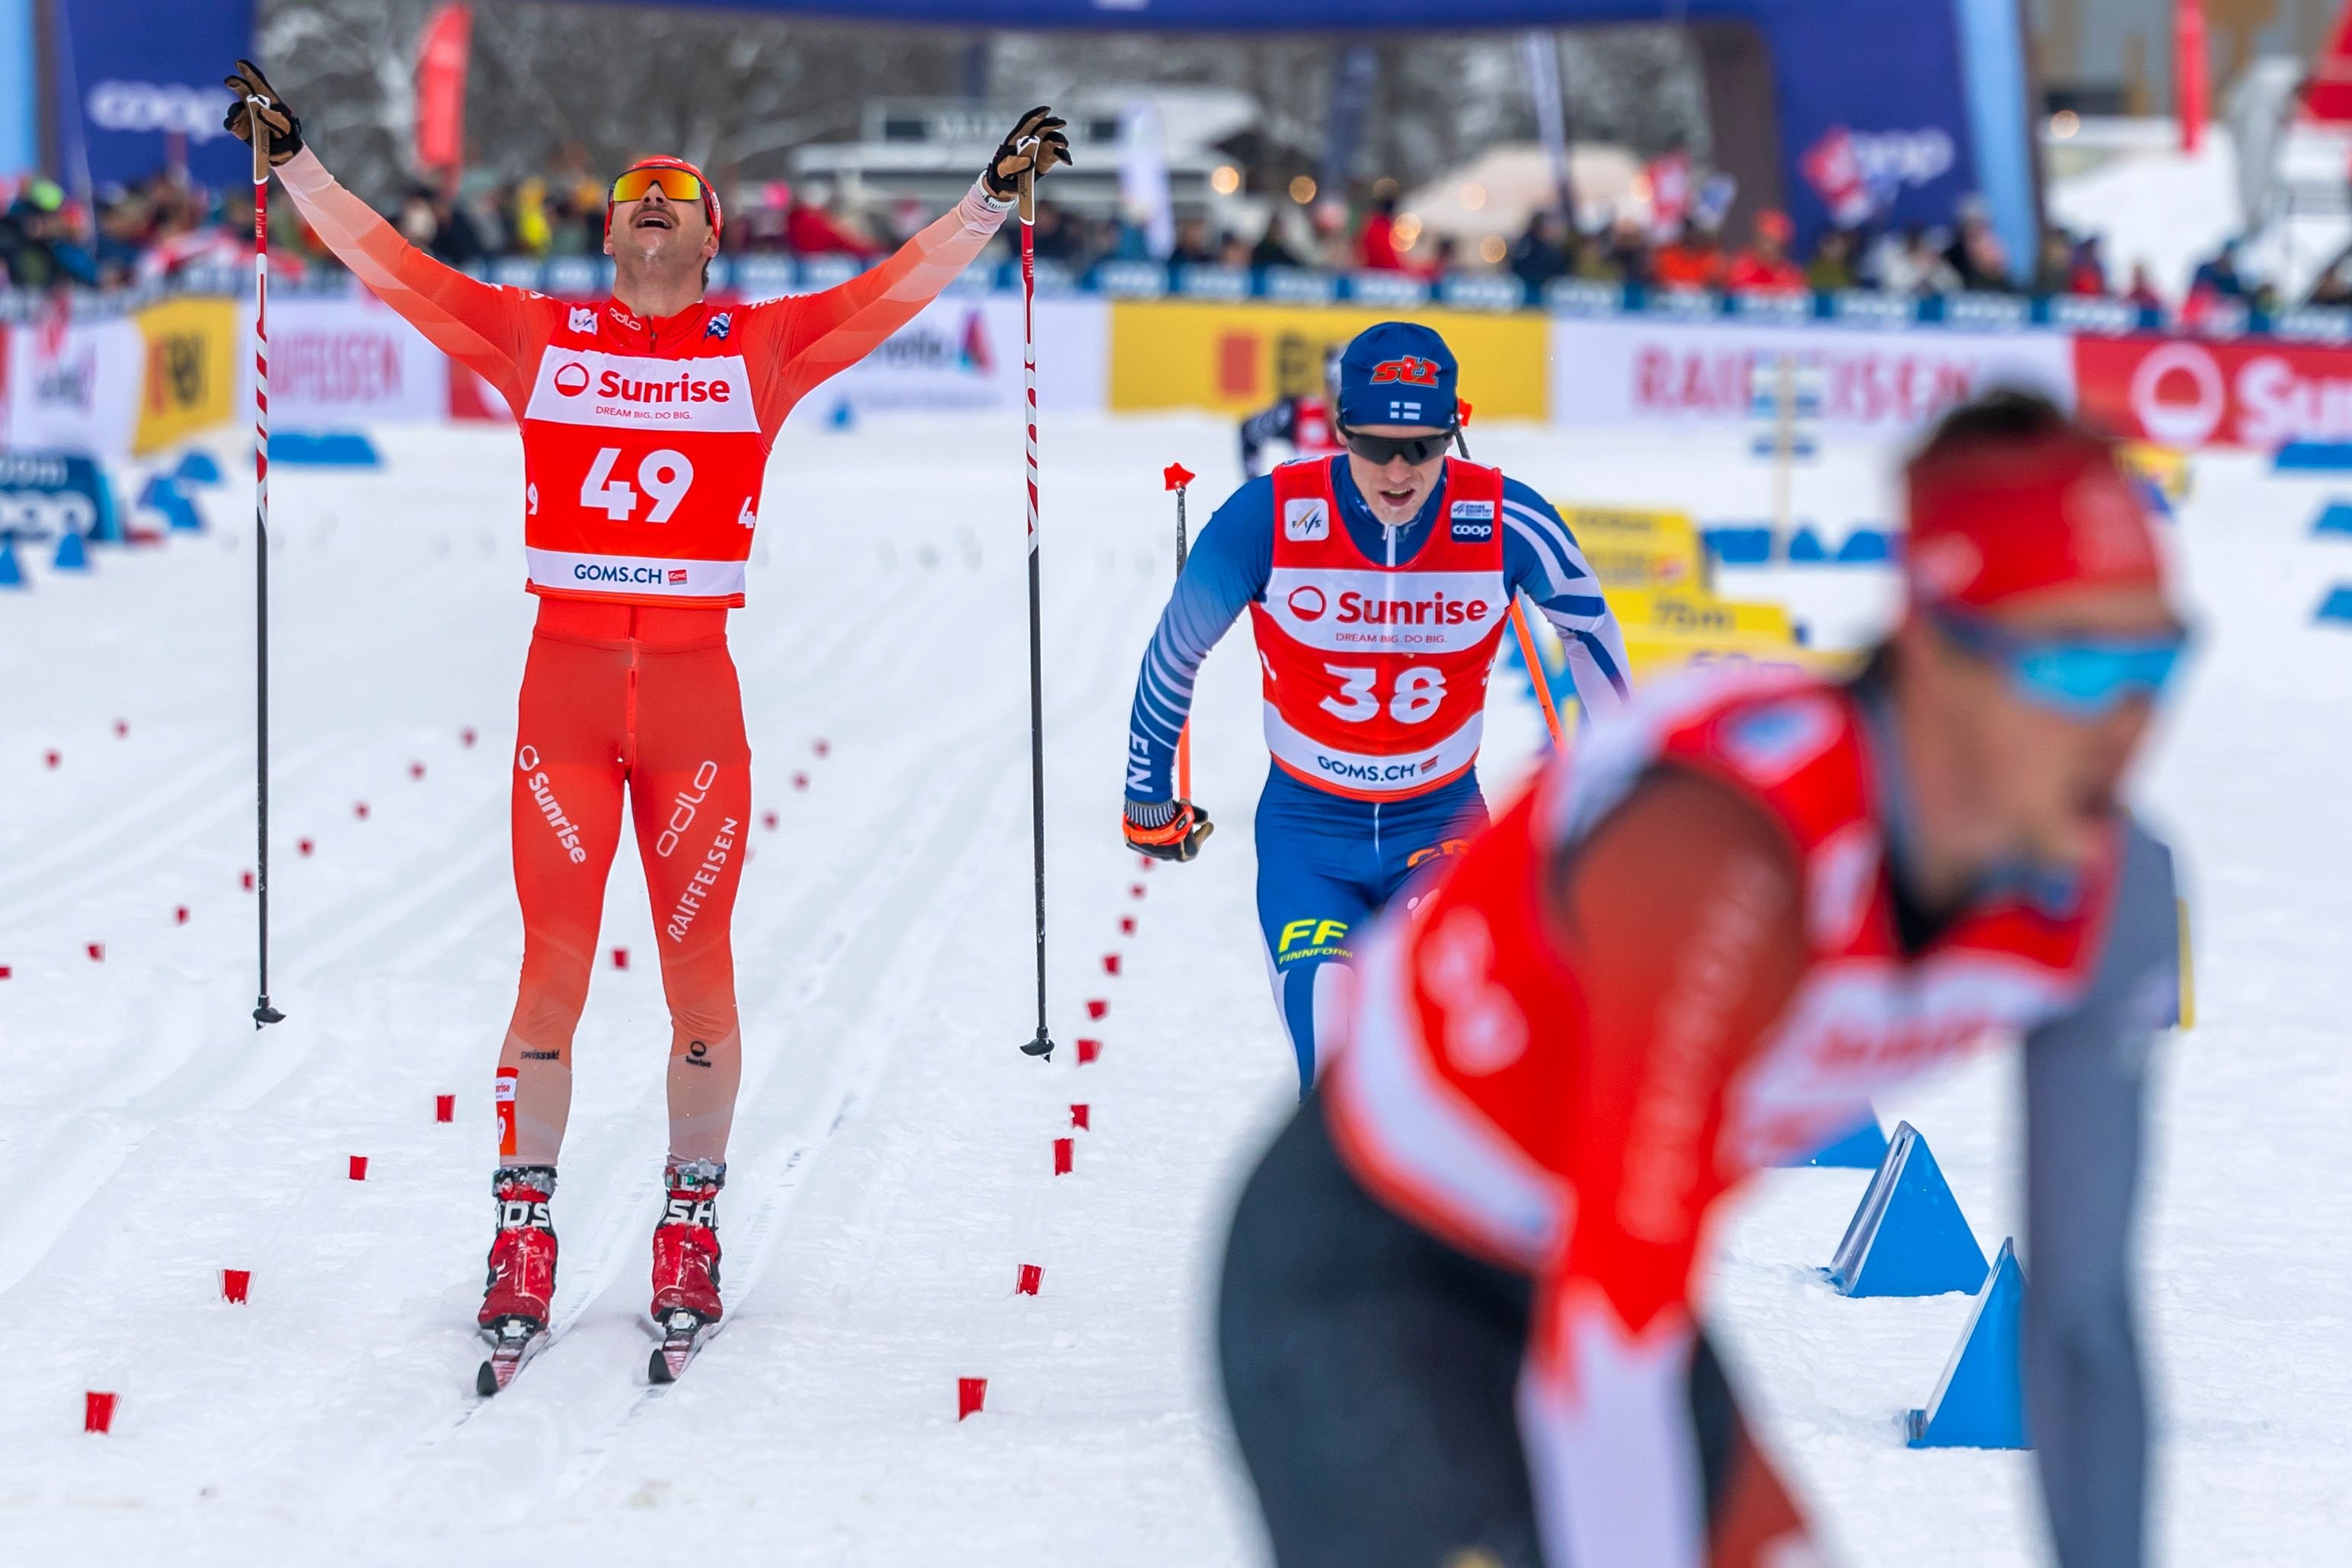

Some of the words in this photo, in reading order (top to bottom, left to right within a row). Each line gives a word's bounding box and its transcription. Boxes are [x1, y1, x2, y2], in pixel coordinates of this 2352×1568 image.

[609, 307, 641, 331] odlo
[596, 369, 731, 403] Sunrise
[596, 405, 631, 418] DREAM
[634, 410, 654, 420] BIG.
[655, 411, 671, 420] DO
[673, 411, 693, 420] BIG.
[579, 447, 695, 524] 49
[1452, 525, 1492, 537] coop
[574, 564, 662, 584] GOMS.CH
[1335, 591, 1489, 625] Sunrise
[1335, 633, 1377, 643] DREAM
[1380, 634, 1401, 643] BIG.
[1404, 634, 1423, 643] DO
[1426, 634, 1447, 643] BIG.
[1318, 662, 1448, 724] 38
[1126, 730, 1153, 794] FIN
[1317, 755, 1415, 781] GOMS.CH
[528, 771, 586, 864] Sunrise
[656, 760, 718, 857] odlo
[667, 817, 738, 943] RAIFFEISEN
[1278, 918, 1349, 953] FF
[1279, 947, 1353, 965] FINNFORM
